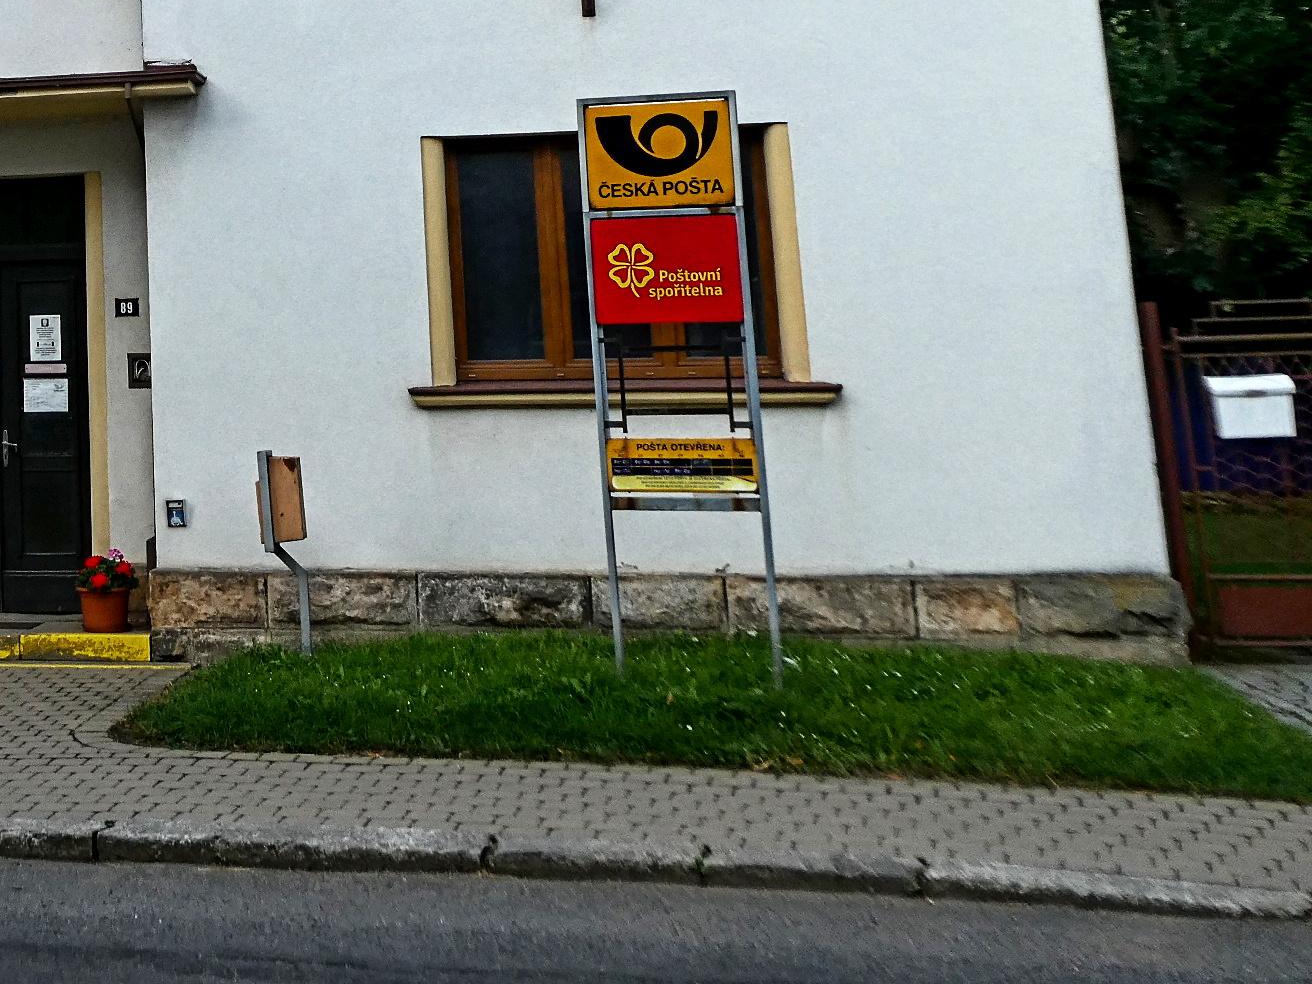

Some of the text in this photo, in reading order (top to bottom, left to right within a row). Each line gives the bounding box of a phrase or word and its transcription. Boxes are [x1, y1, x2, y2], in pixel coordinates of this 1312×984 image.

[598, 177, 724, 199] ČESKÁ POŠTA
[659, 268, 721, 282] Poštovní
[649, 283, 723, 300] spořitelna
[120, 302, 133, 314] 89
[636, 441, 725, 452] POŠTA OTEVŘENA:
